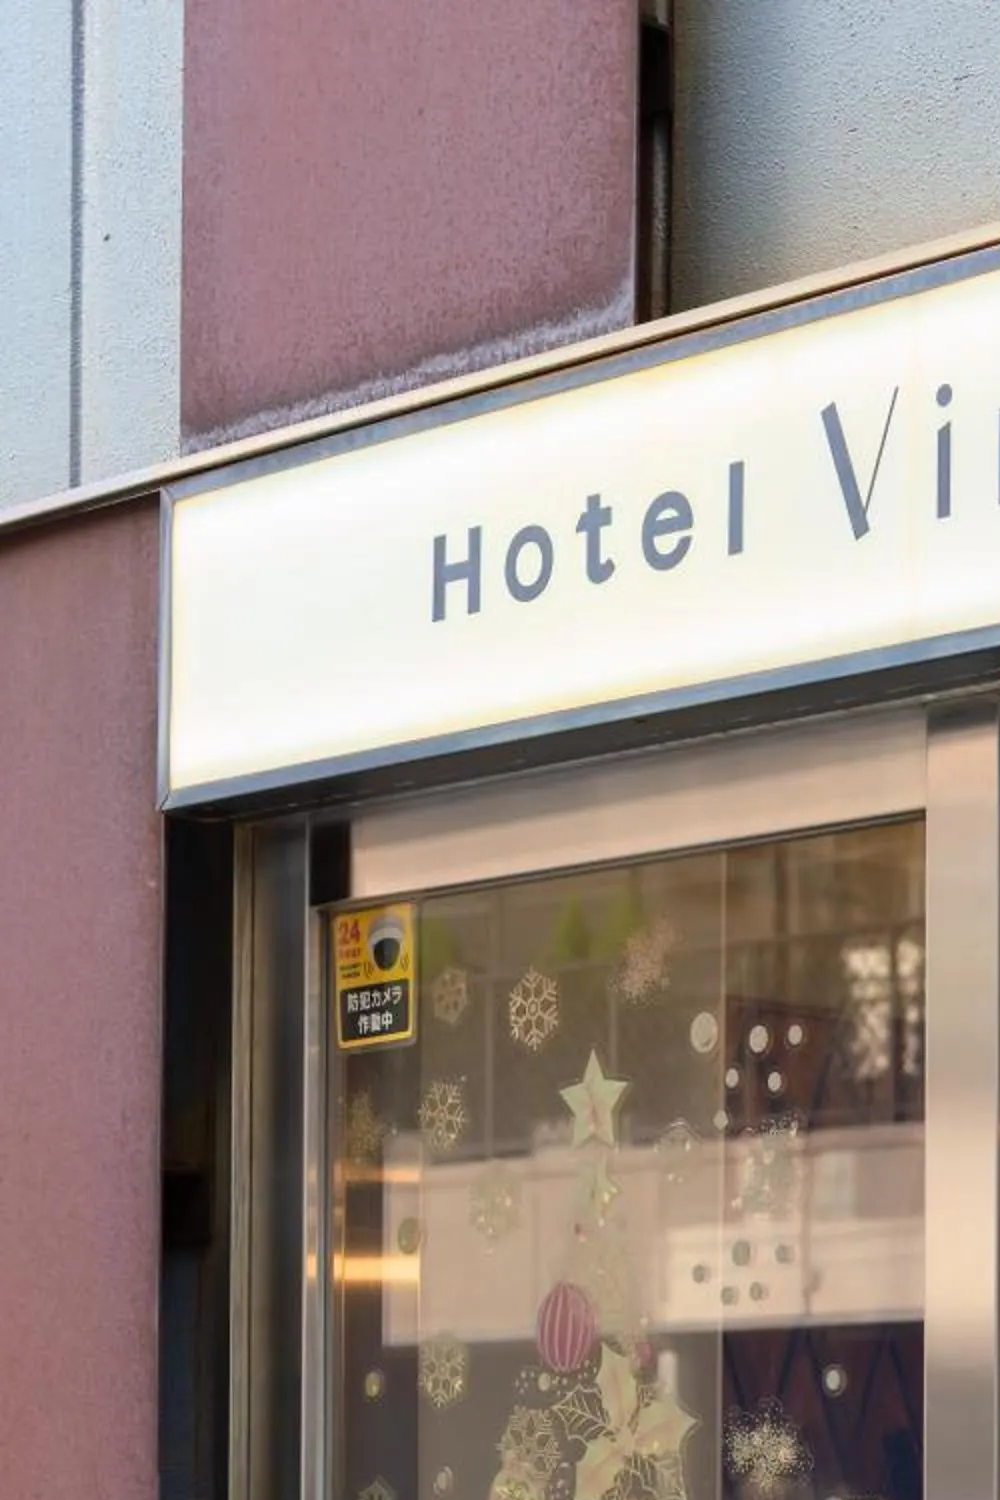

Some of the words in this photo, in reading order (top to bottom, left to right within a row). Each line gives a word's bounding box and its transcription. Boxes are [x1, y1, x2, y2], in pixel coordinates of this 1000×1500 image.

[432, 461, 745, 622] Hotel
[339, 919, 361, 944] 24
[347, 985, 403, 1013] 防犯カメラ
[357, 1010, 394, 1035] 作動中
